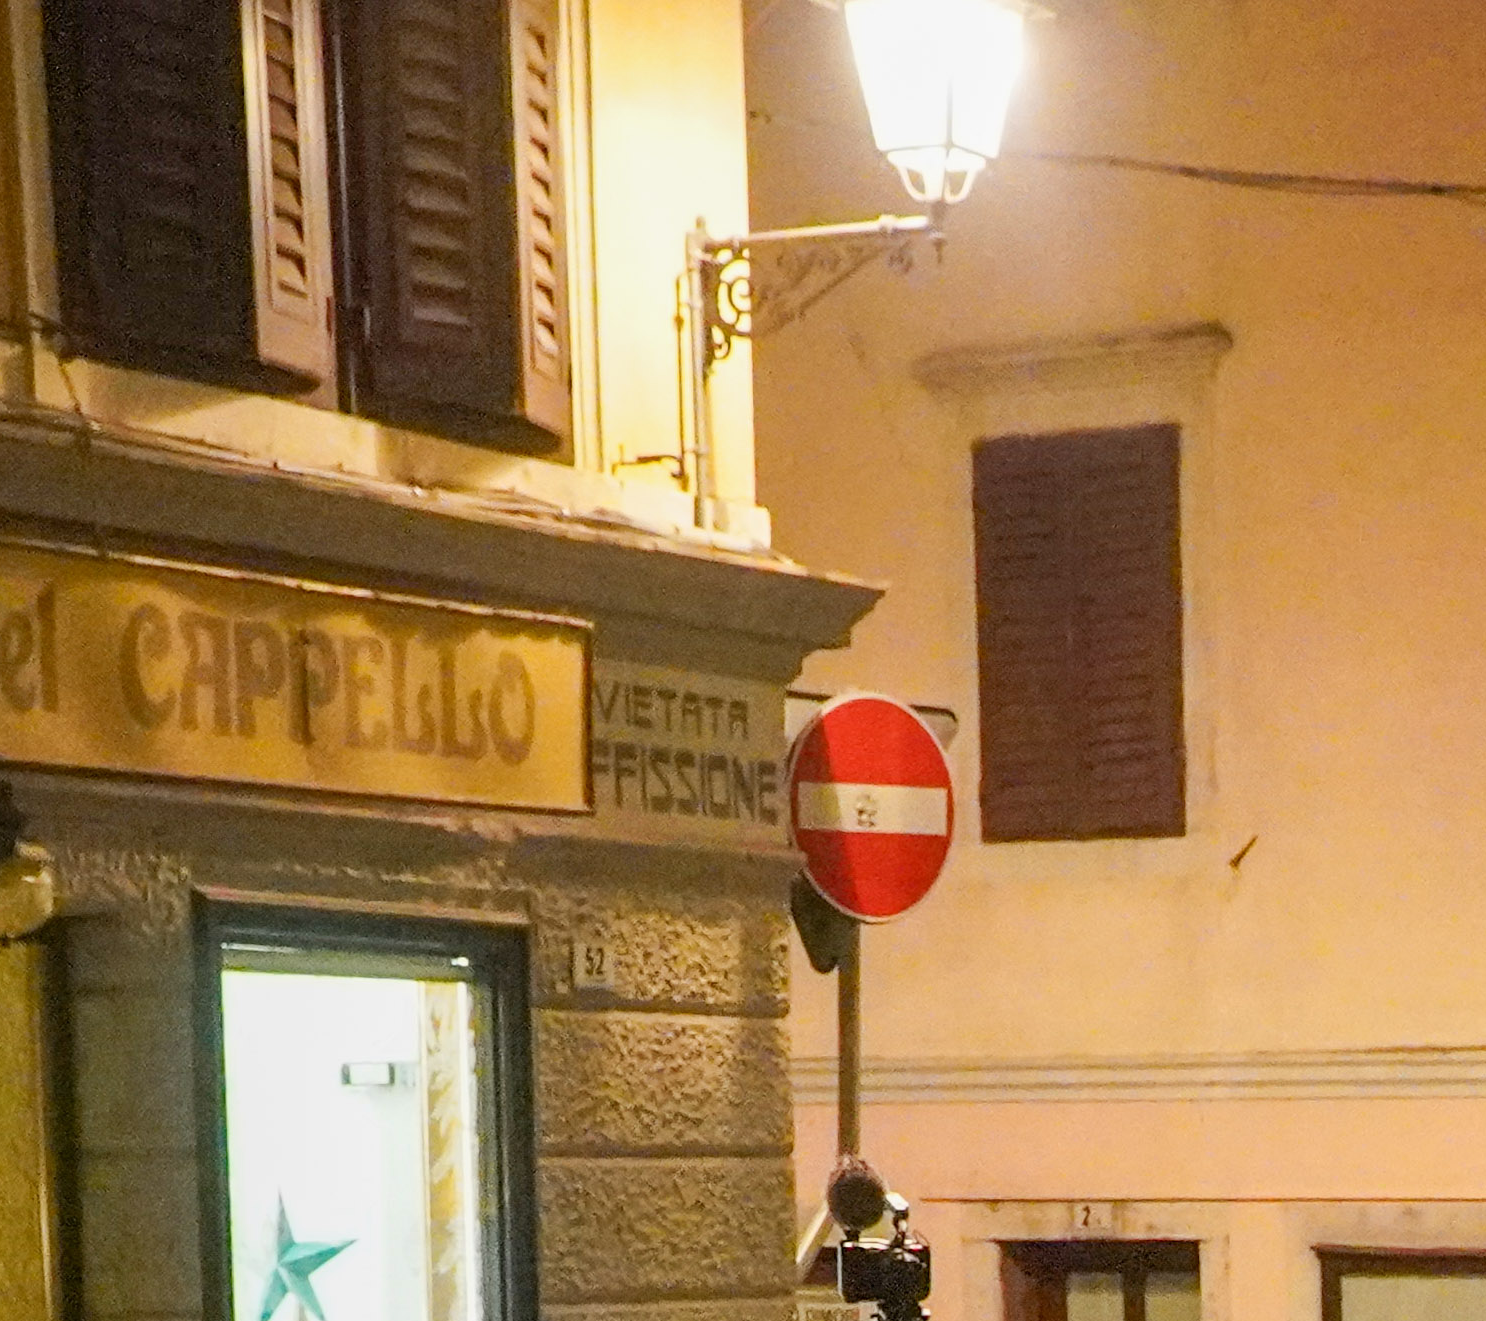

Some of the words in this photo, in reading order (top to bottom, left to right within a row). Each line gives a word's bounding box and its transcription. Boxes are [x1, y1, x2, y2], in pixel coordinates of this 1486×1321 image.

[119, 602, 537, 766] CAPPELLO
[595, 685, 749, 739] VIETATA
[585, 947, 604, 976] 52
